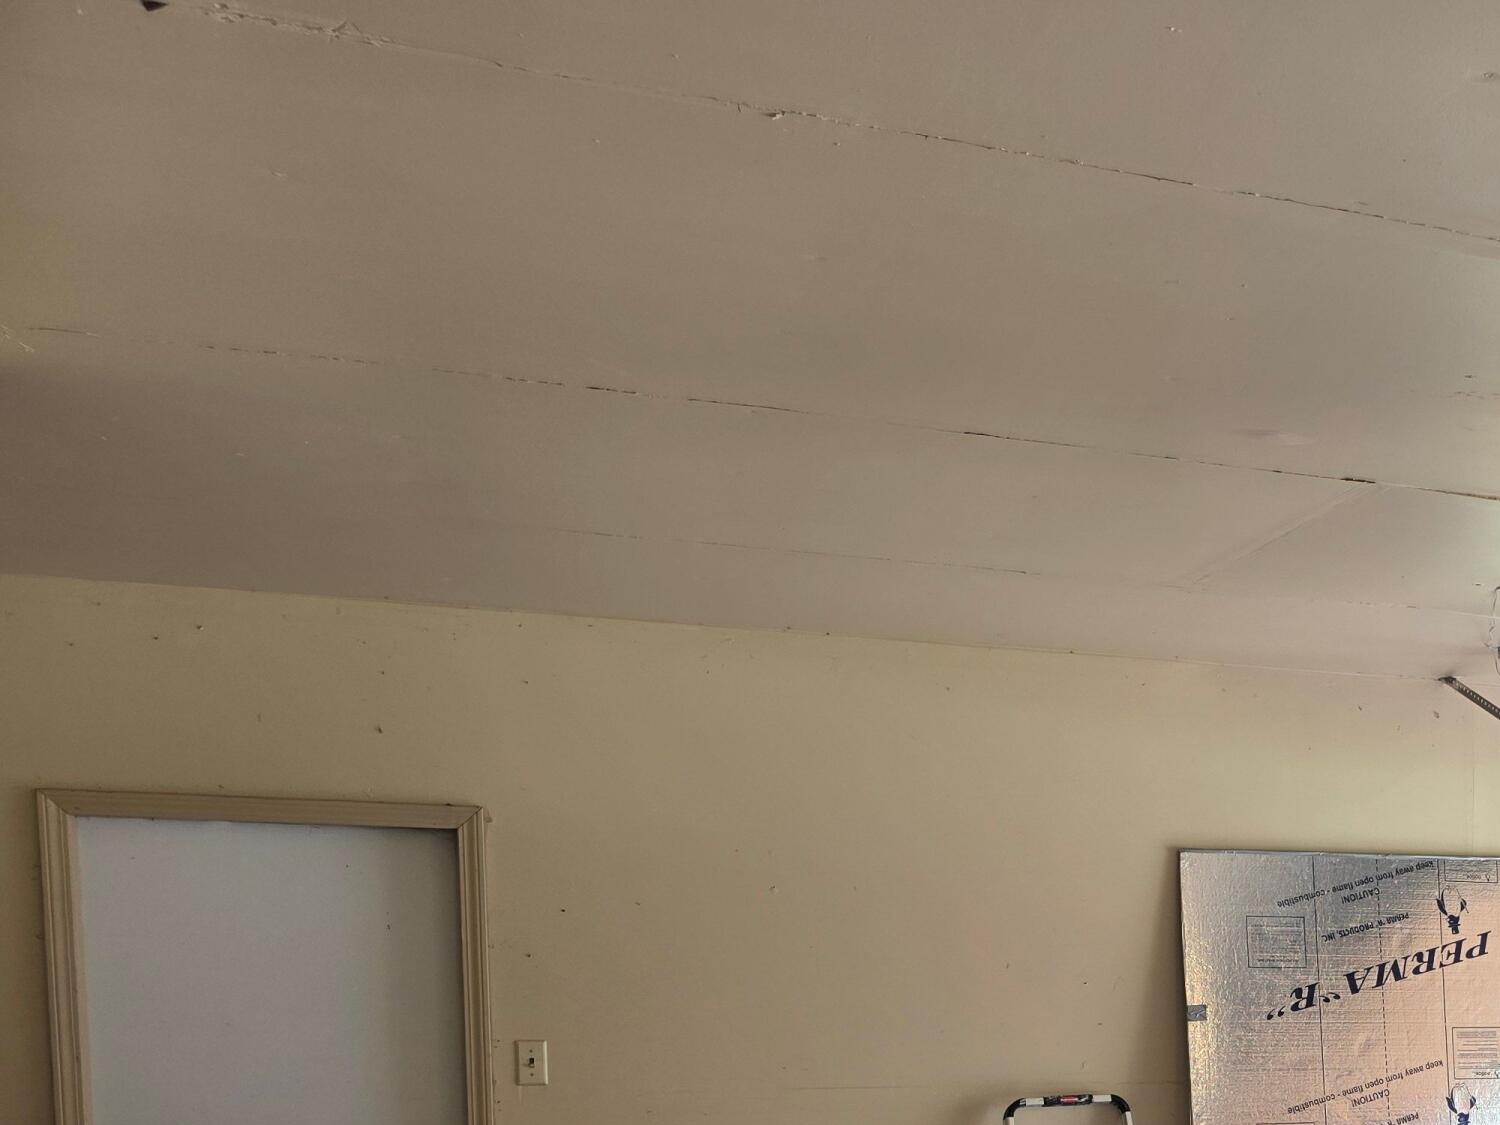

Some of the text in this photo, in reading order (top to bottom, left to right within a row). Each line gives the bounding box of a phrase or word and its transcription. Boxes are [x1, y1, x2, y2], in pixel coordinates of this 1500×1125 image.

[1395, 864, 1414, 875] away
[1413, 860, 1434, 871] keep
[1376, 871, 1394, 882] from
[1332, 882, 1353, 893] flame
[1354, 877, 1374, 889] open
[1277, 890, 1326, 908] combustible
[1341, 887, 1380, 904] CAUTION!
[1385, 912, 1410, 925] PERMA
[1343, 930, 1492, 995] PERMA
[1405, 1065, 1424, 1077] away
[1424, 1060, 1444, 1071] keep
[1385, 1072, 1404, 1083] from
[1342, 1083, 1364, 1096] flame
[1364, 1078, 1383, 1090] open
[1287, 1093, 1336, 1114] combustible
[1351, 1088, 1390, 1108] CAUTION!
[1396, 1112, 1419, 1125] PERMA
